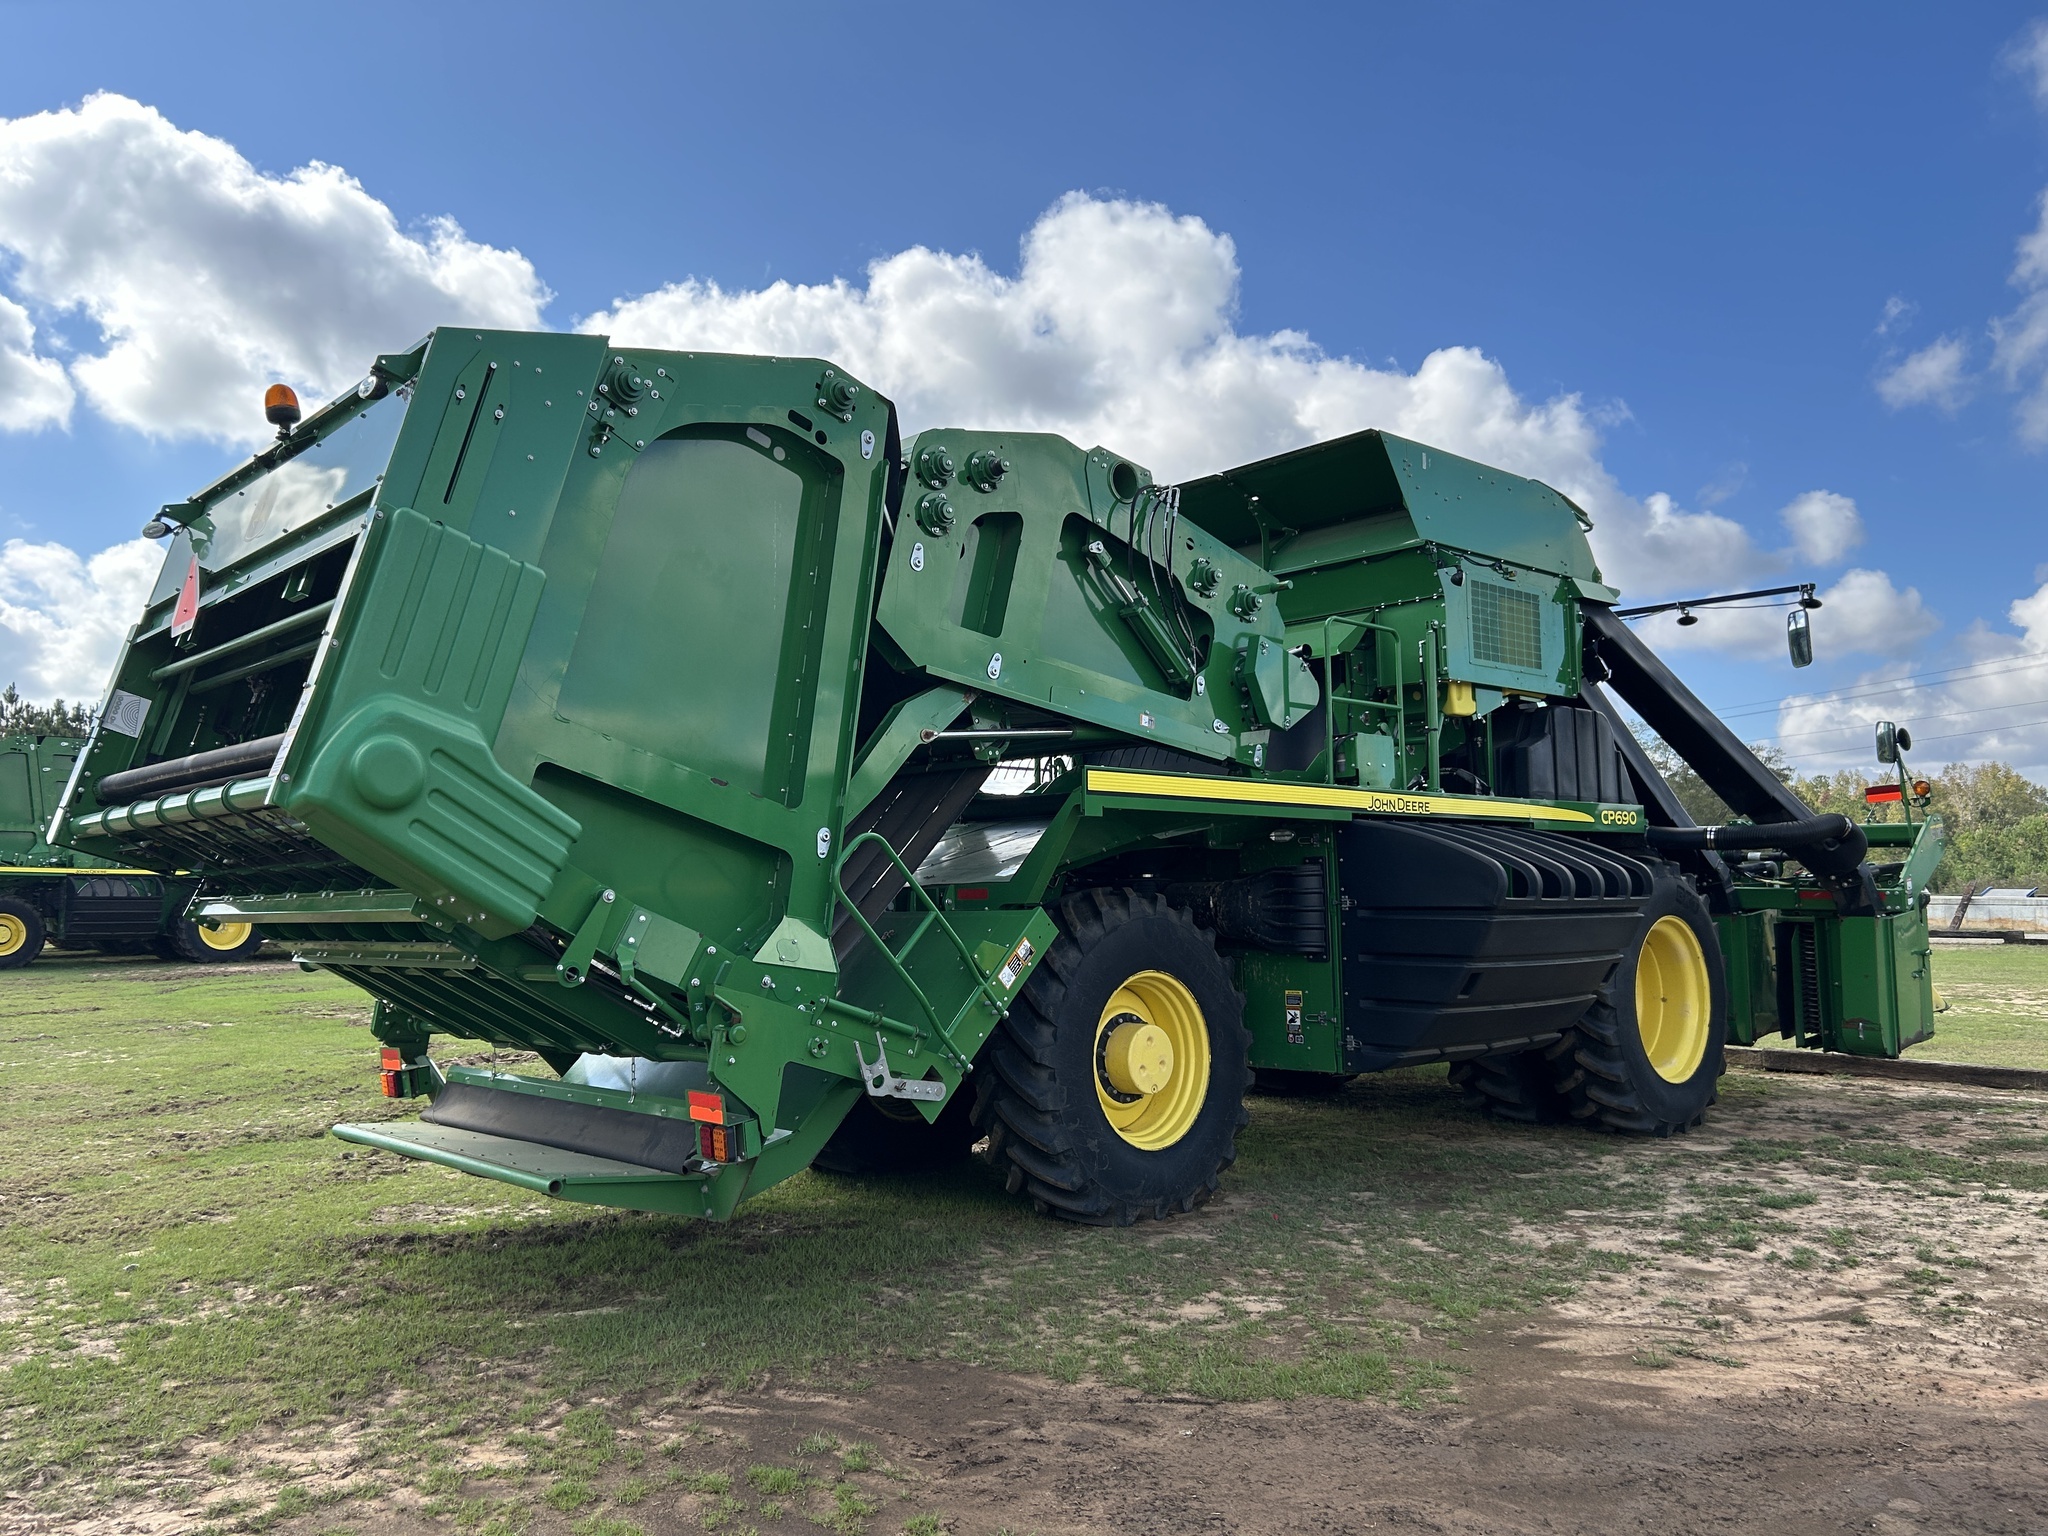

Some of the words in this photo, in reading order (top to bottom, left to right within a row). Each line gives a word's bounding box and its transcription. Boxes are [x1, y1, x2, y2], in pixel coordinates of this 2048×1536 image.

[1367, 795, 1397, 811] JOHN
[1397, 797, 1431, 813] DEERE
[1601, 809, 1637, 826] CP690
